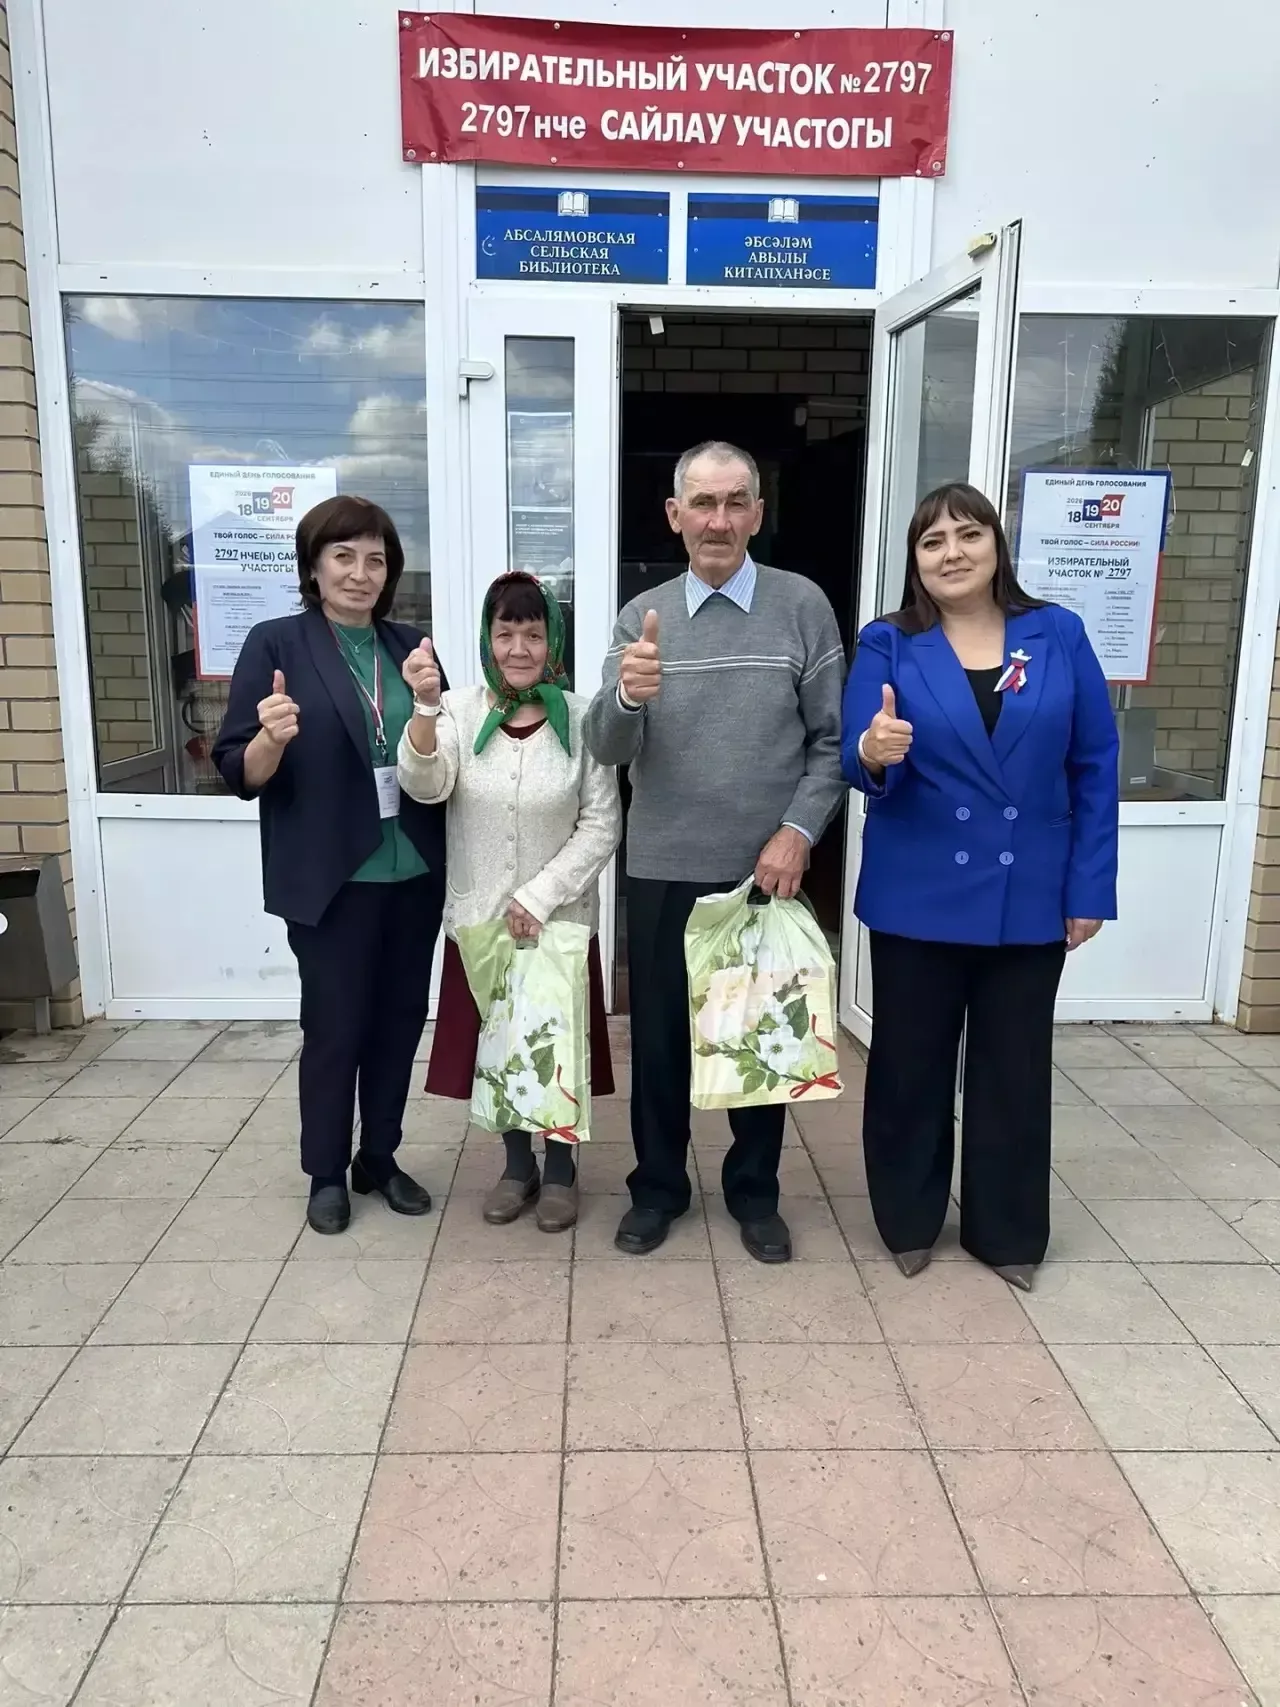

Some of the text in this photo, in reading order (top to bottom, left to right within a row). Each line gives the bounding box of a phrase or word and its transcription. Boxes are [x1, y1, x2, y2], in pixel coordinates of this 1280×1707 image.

[419, 47, 687, 91] ИЗБИРАТЕЛЬНЫЙ
[695, 61, 836, 95] УЧАСТОК
[600, 105, 727, 144] САЙЛАУ
[733, 114, 893, 149] УЧАСТОГЫ
[503, 229, 635, 245] АБСАЛЯМОВСКАЯ
[744, 236, 813, 249] ӘБСӘЛӘМ
[530, 245, 609, 259] СЕЛЬСКАЯ
[748, 252, 808, 264] АВЫЛЫ
[519, 261, 621, 275] БИБЛИОТЕКА
[724, 267, 831, 280] КИТАПХАНӘСЕ
[210, 470, 241, 478] ЕДИНЫЙ
[1045, 478, 1075, 486] ЕДИНЫЙ
[1076, 479, 1094, 487] ДЕНЬ
[237, 491, 291, 516] 18 19 20
[1067, 499, 1120, 523] 18 19 20
[213, 531, 233, 539] ТВОЙ
[214, 548, 298, 562] 2797 НЧЕ(Ы) САЙ
[1047, 556, 1130, 567] ИЗБИРАТЕЛЬНЫЙ
[240, 563, 294, 573] УЧАСТОГЫ
[1048, 569, 1092, 578] УЧАСТОК
[1108, 567, 1132, 577] 2797
